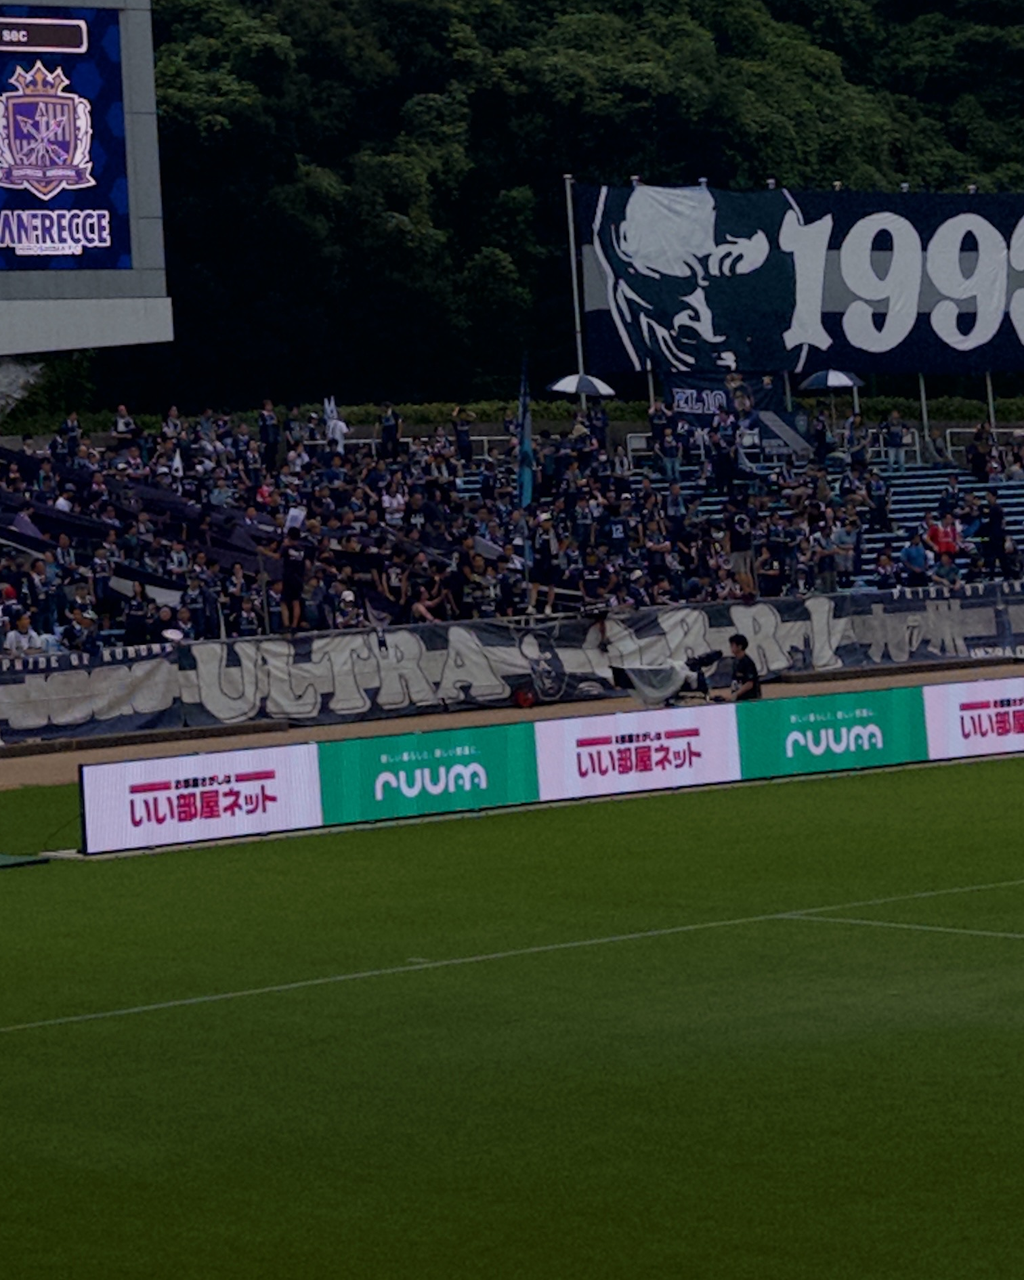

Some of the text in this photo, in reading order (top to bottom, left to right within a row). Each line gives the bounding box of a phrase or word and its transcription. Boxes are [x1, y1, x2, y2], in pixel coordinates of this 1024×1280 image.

[2, 29, 28, 42] sec
[779, 209, 1024, 354] 199
[612, 524, 624, 538] 12
[190, 626, 511, 723] ULTRA
[576, 741, 702, 778] いい部屋ネット
[786, 723, 883, 758] ruum
[375, 762, 488, 801] ruum
[129, 784, 278, 828] いい部屋ネット
